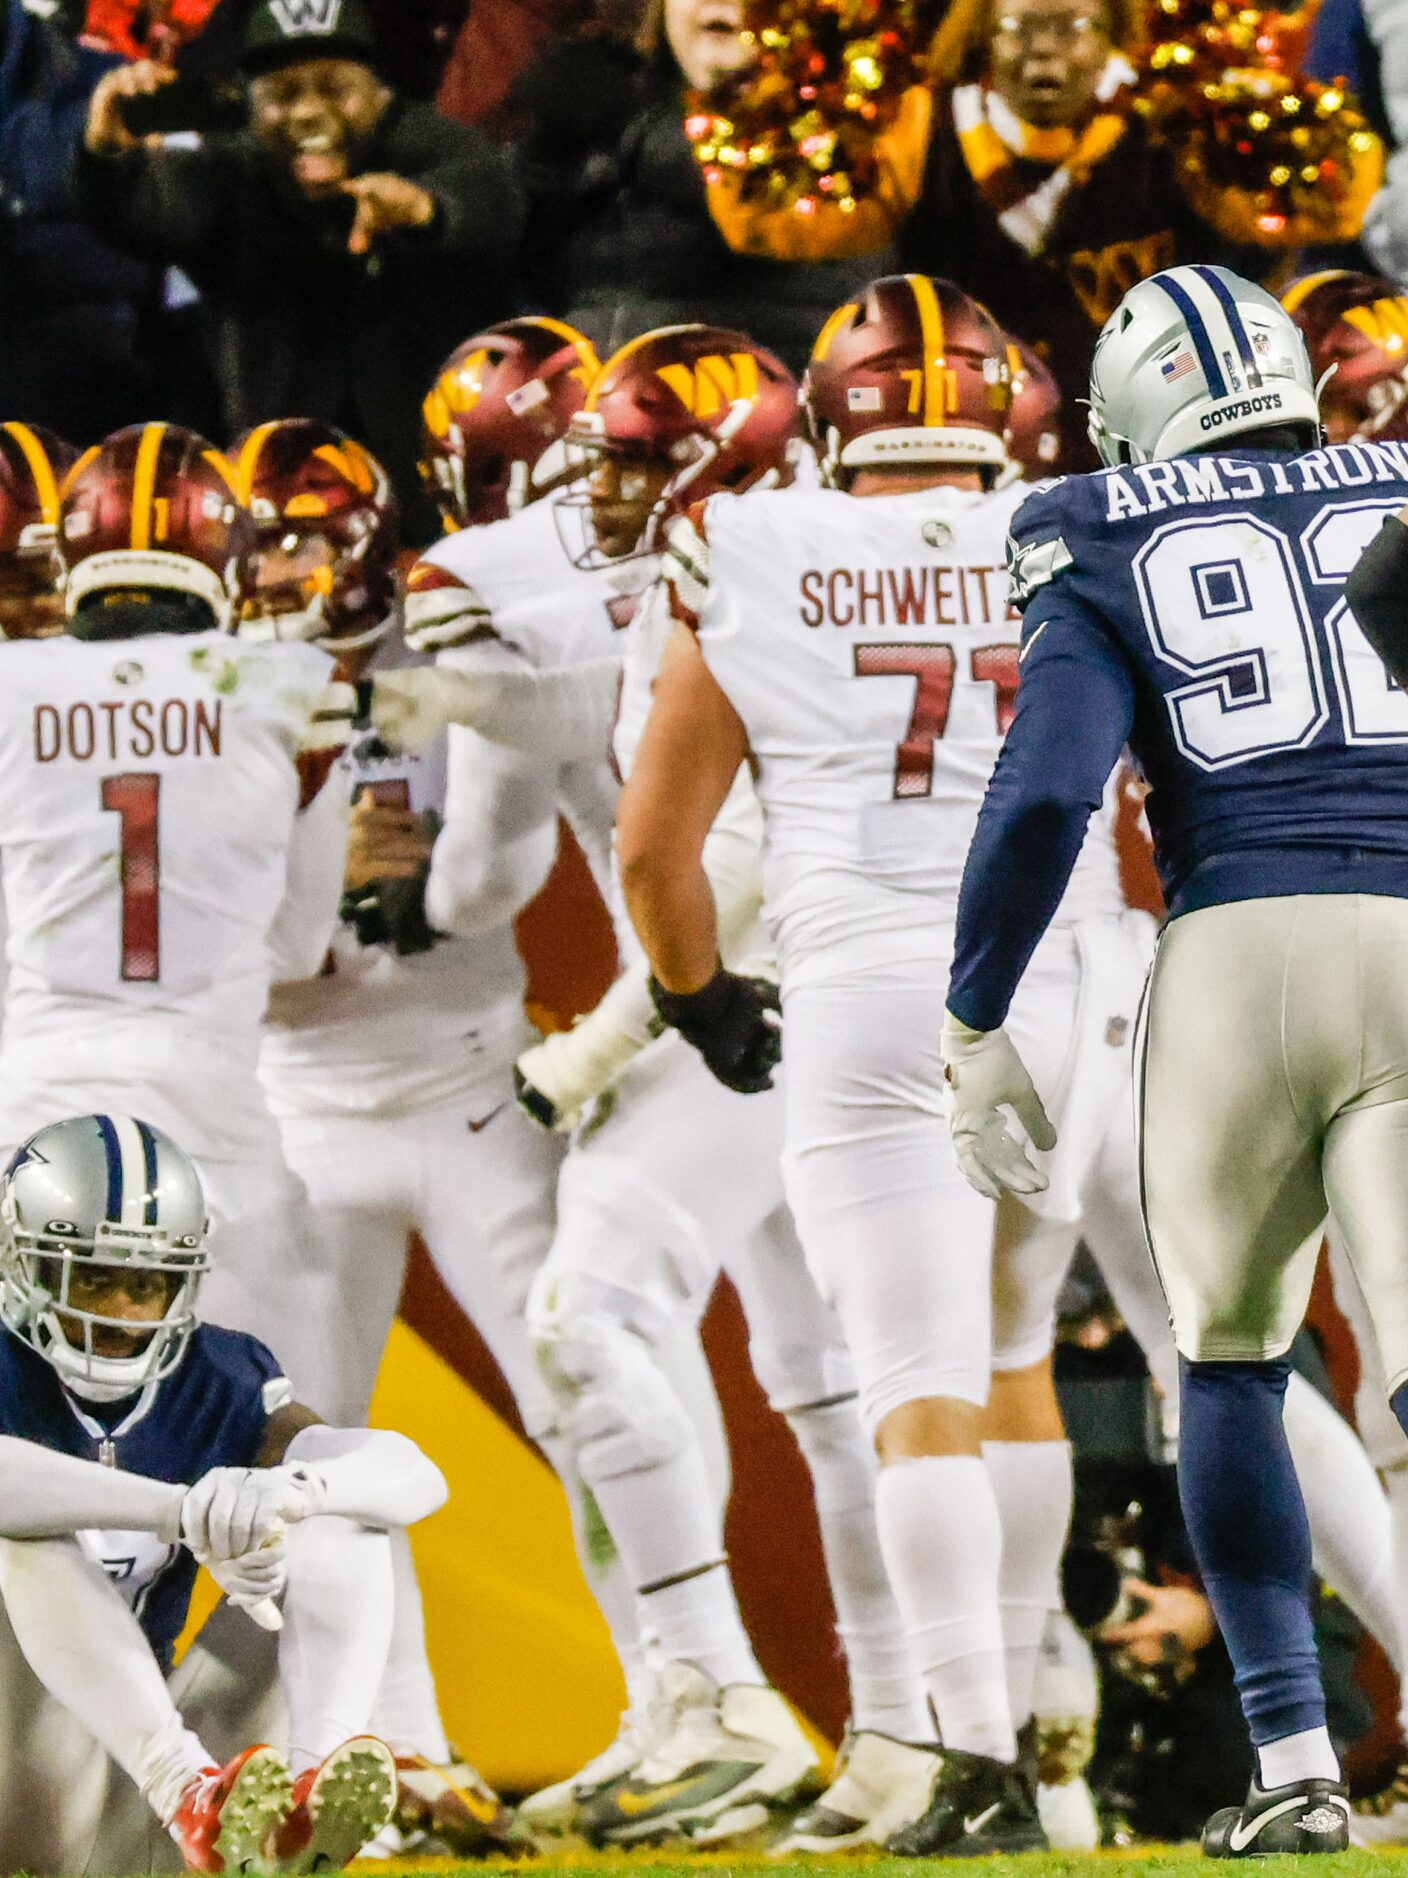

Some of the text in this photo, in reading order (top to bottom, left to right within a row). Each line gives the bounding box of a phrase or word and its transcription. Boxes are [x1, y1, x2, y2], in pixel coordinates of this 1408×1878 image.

[900, 368, 960, 414] 71
[1200, 393, 1283, 431] COWBOYS
[34, 697, 223, 762] DOTSON
[100, 771, 161, 982] 1
